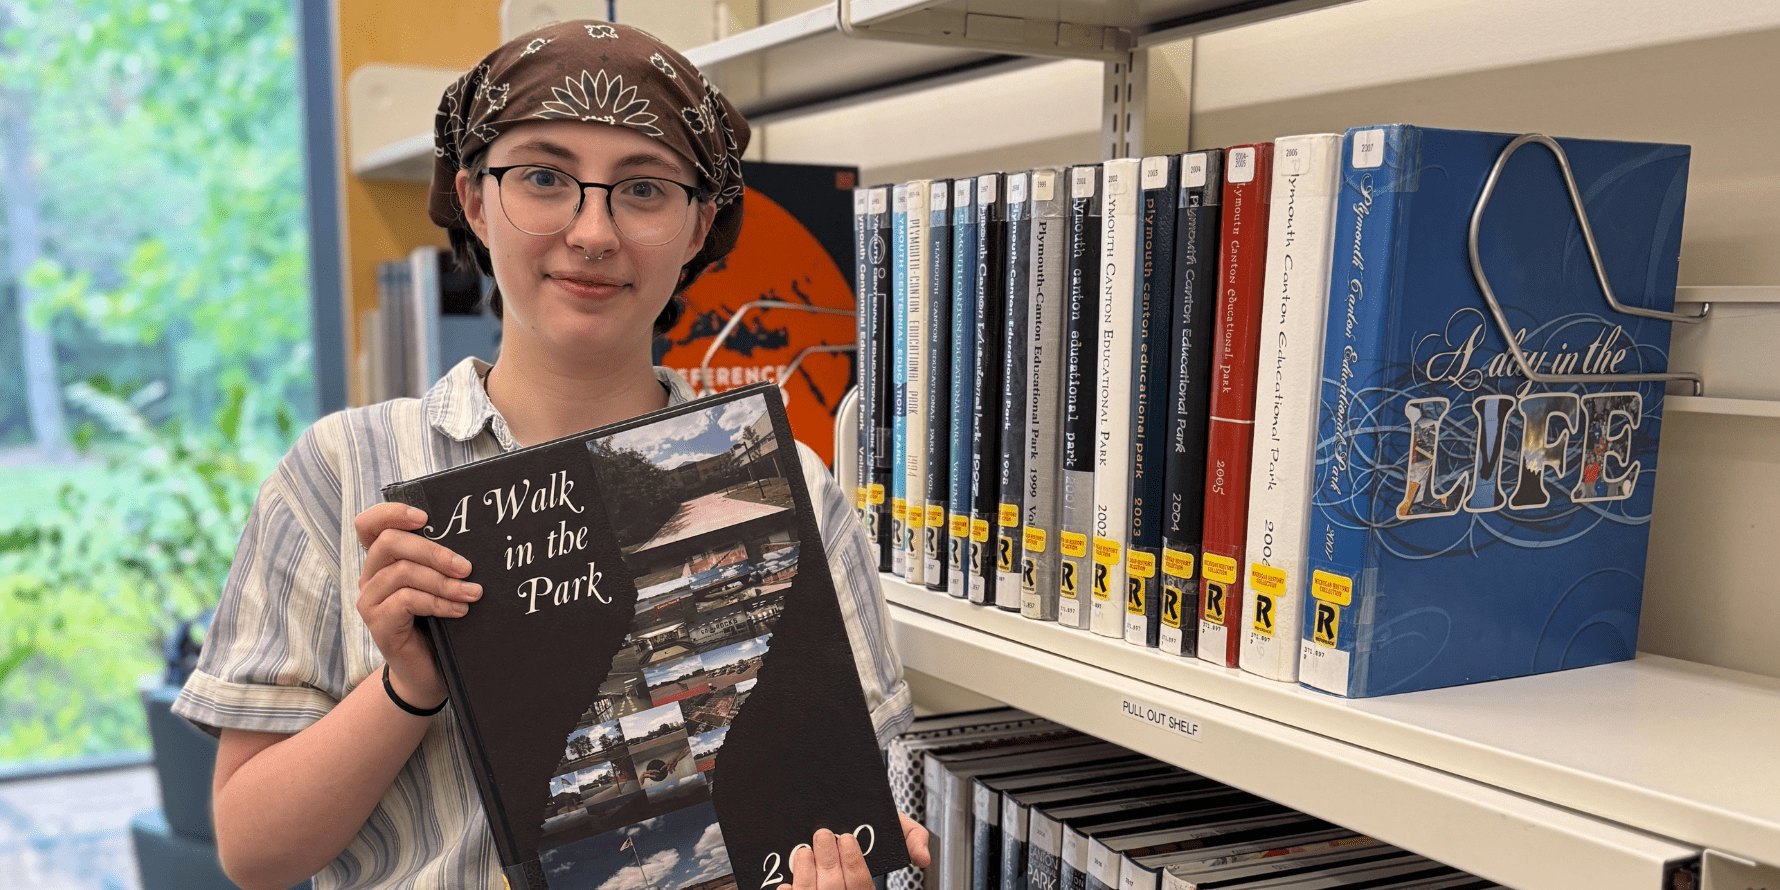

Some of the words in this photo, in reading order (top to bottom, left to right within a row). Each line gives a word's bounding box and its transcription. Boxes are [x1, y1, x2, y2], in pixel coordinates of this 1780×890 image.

[1286, 149, 1298, 157] 2006
[1361, 144, 1374, 153] 2007
[872, 214, 880, 264] YMOUTH
[897, 217, 905, 267] YMOUTH
[1072, 198, 1087, 258] lymouth
[1143, 198, 1157, 278] plymouth
[1185, 195, 1199, 265] Plymouth
[1352, 173, 1374, 266] Plymouth
[859, 264, 867, 328] Centennial
[1034, 221, 1047, 341] Plymouth-Canton
[1071, 269, 1084, 321] canton
[1103, 263, 1117, 323] CANTON
[1182, 269, 1196, 323] Canton
[1280, 254, 1294, 324] Canton
[956, 282, 964, 332] CANTON
[1140, 283, 1151, 338] canton
[1344, 277, 1363, 339] Canton
[858, 331, 867, 402] Educational
[908, 320, 919, 382] EDUCATIONAL
[953, 333, 962, 417] EDUCATIONAL
[1004, 320, 1014, 396] Educational
[1067, 330, 1082, 422] educational
[1177, 328, 1192, 418] Educational
[1412, 307, 1486, 391] A
[1488, 328, 1548, 398] day
[1550, 343, 1580, 375] in
[1582, 325, 1626, 375] the
[676, 366, 790, 388] EFERENCE
[896, 348, 904, 429] EDUCATIONAL
[930, 349, 938, 421] EDUCATIONAL
[1030, 346, 1044, 427] Educational
[1099, 330, 1114, 425] EDUCATIONAL
[1136, 343, 1149, 439] educational
[1270, 331, 1288, 442] Educational
[1335, 345, 1358, 440] Educational
[908, 390, 919, 415] PARK
[1003, 400, 1012, 431] Park
[952, 418, 960, 446] PARK
[1029, 429, 1041, 460] Park
[1064, 432, 1077, 467] park
[1098, 431, 1110, 467] PARK
[1174, 418, 1187, 453] Park
[1396, 391, 1643, 520] LIFE
[1002, 453, 1010, 486] 1998
[1028, 467, 1039, 498] 1999
[1134, 443, 1147, 479] park
[1211, 460, 1225, 496] 2005
[1267, 447, 1280, 491] Park
[1330, 439, 1349, 496] Park
[423, 494, 473, 541] A
[483, 470, 585, 525] Walk
[1028, 505, 1037, 527] Vol
[1097, 504, 1108, 537] 2002
[1132, 497, 1143, 537] 2003
[1171, 493, 1182, 532] 2004
[504, 535, 535, 571] in
[547, 520, 588, 559] the
[1324, 523, 1337, 562] 2007
[517, 562, 613, 615] Park
[1023, 560, 1035, 587] R
[1061, 562, 1074, 591] R
[1094, 562, 1107, 593] R
[1128, 577, 1143, 608] R
[1164, 588, 1178, 621] R
[1206, 583, 1223, 617] R
[1256, 594, 1272, 629] R
[1316, 604, 1335, 640] R
[1122, 700, 1145, 719] PULL
[1147, 709, 1167, 726] OUT
[1168, 716, 1199, 736] SHELF
[759, 823, 875, 889] 200
[1028, 863, 1057, 890] PARK
